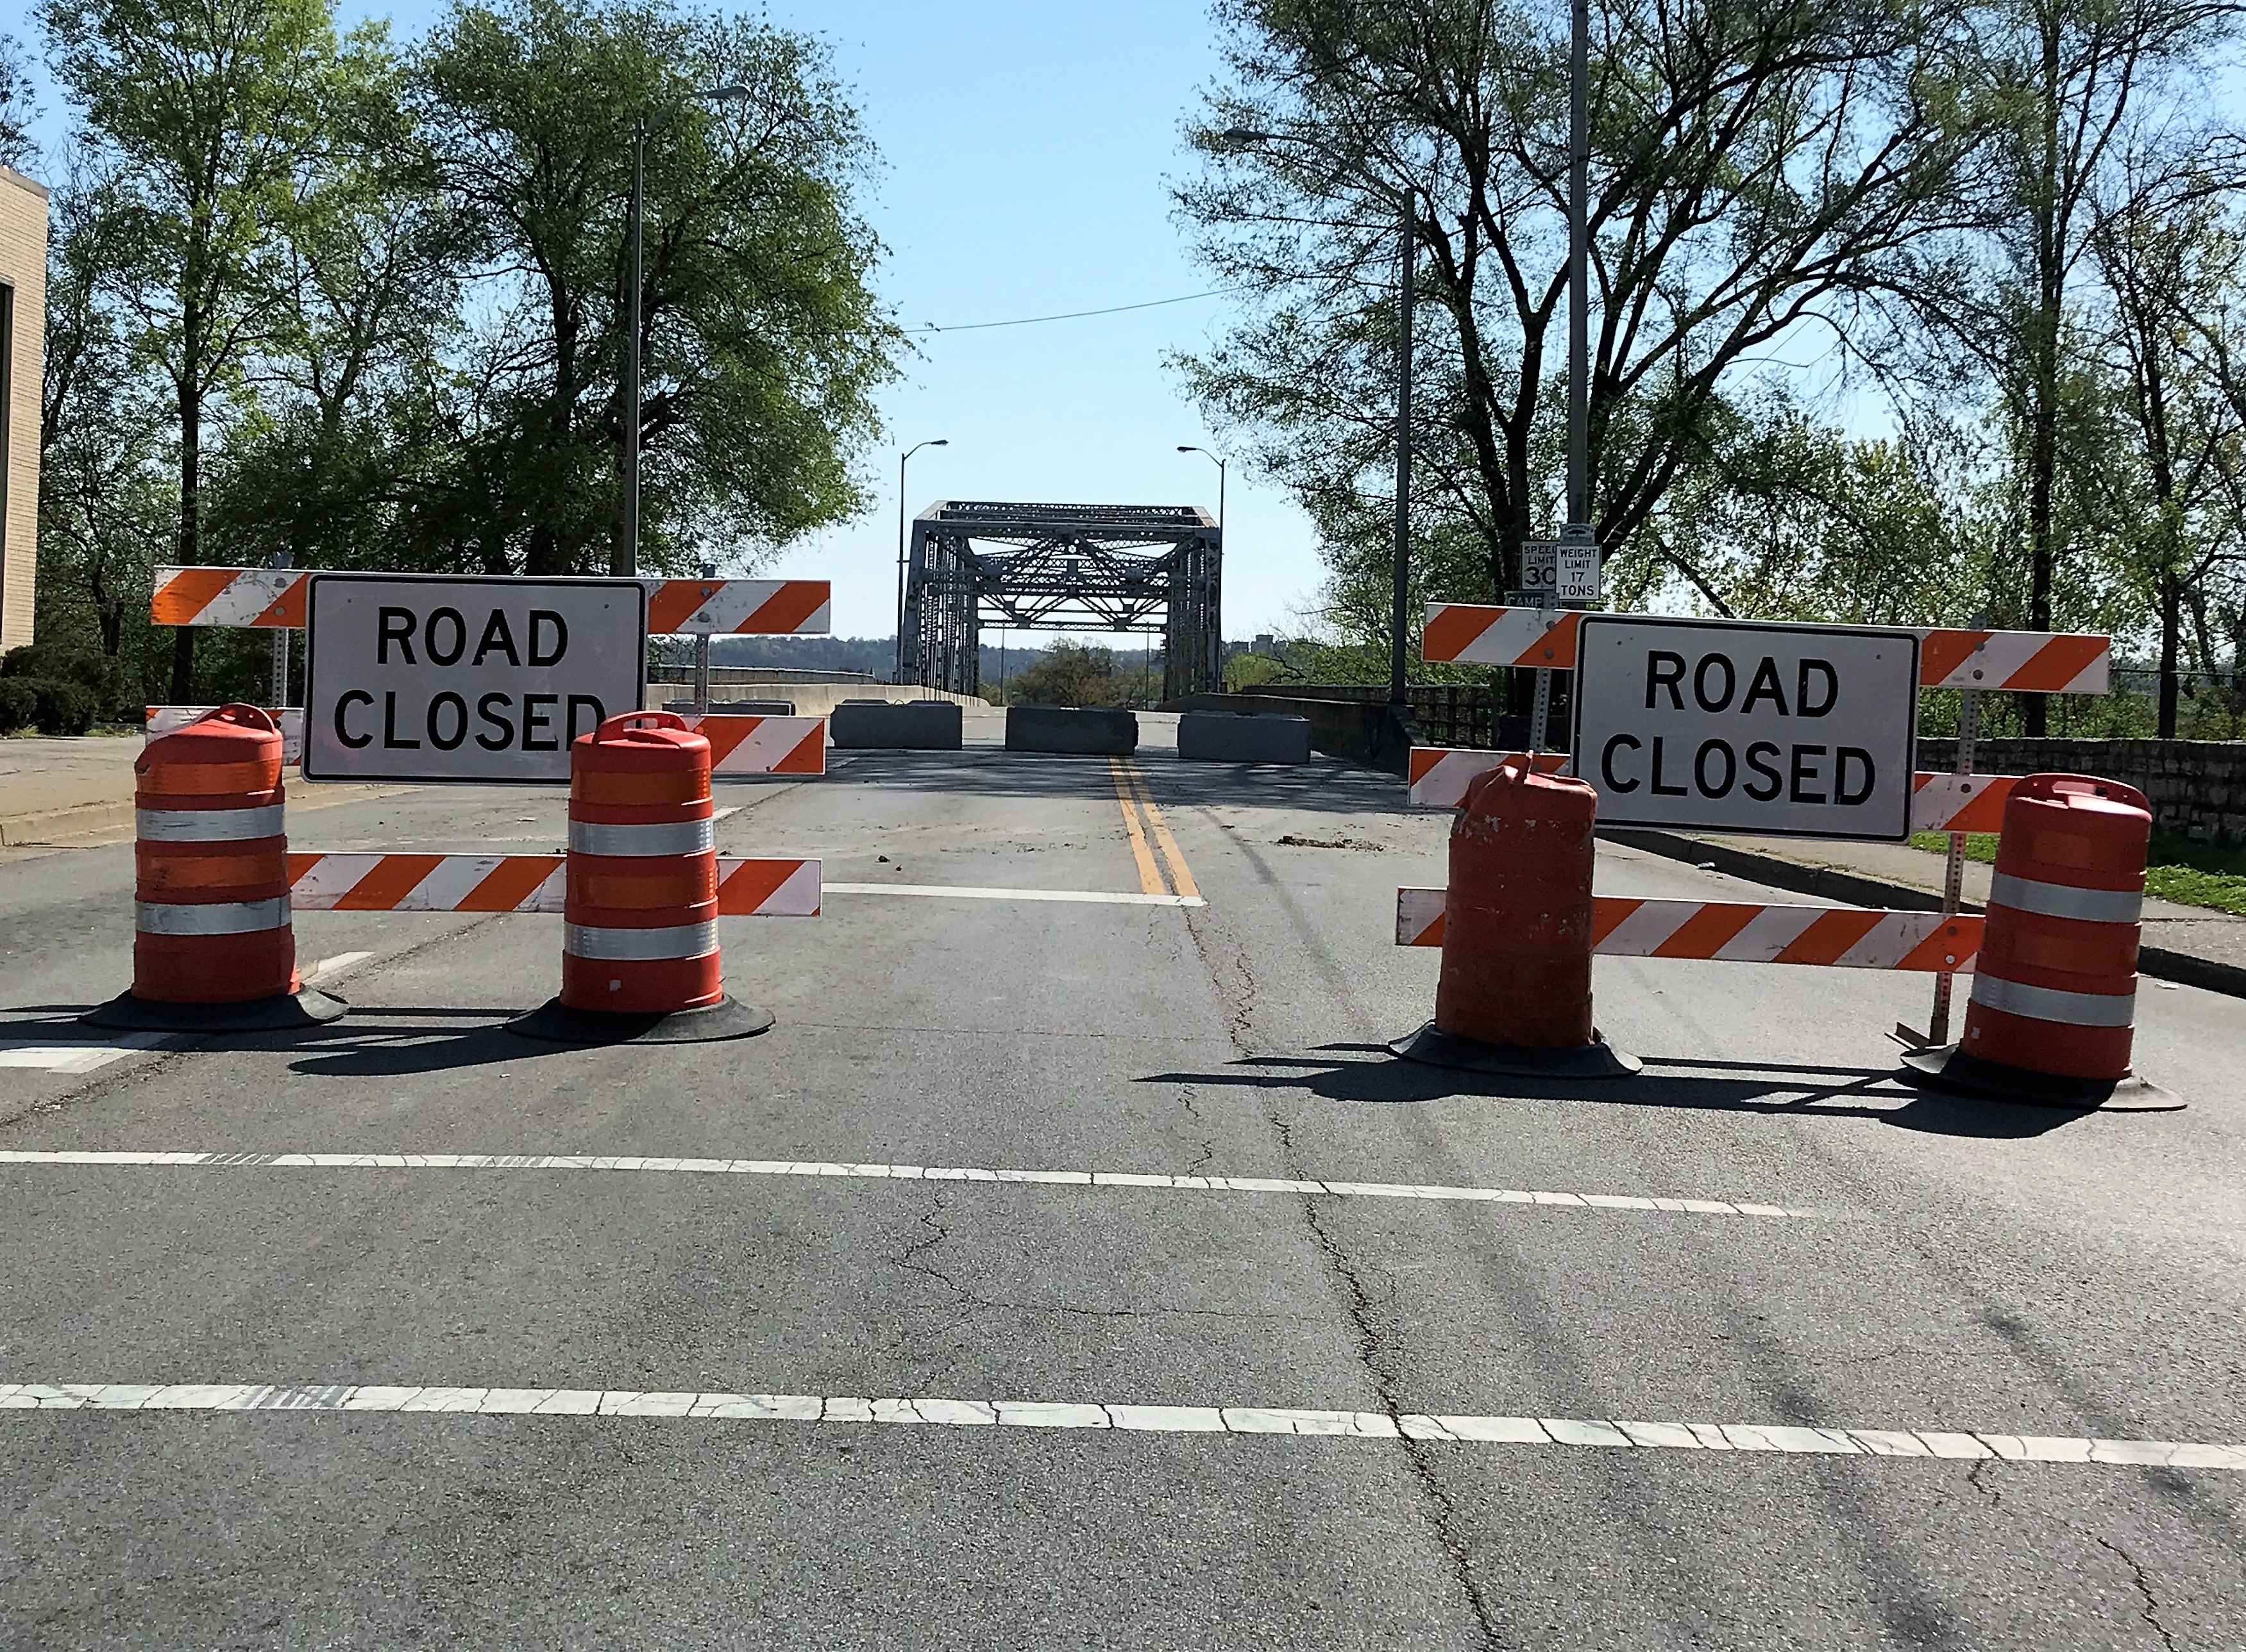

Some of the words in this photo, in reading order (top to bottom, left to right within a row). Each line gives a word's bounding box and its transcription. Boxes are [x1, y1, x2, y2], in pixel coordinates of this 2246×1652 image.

[1524, 546, 1555, 554] SPEE
[1560, 549, 1597, 558] WEIGHT
[1528, 556, 1555, 564] LIMIT
[1565, 560, 1591, 569] LIMIT
[1524, 566, 1555, 586] 30
[1571, 572, 1585, 582] 17
[1561, 585, 1594, 596] TONS
[1508, 596, 1542, 607] CAMP
[377, 607, 568, 667] ROAD
[1645, 650, 1839, 718] ROAD
[335, 690, 606, 752] CLOSED
[1601, 734, 1876, 806] CLOSED
